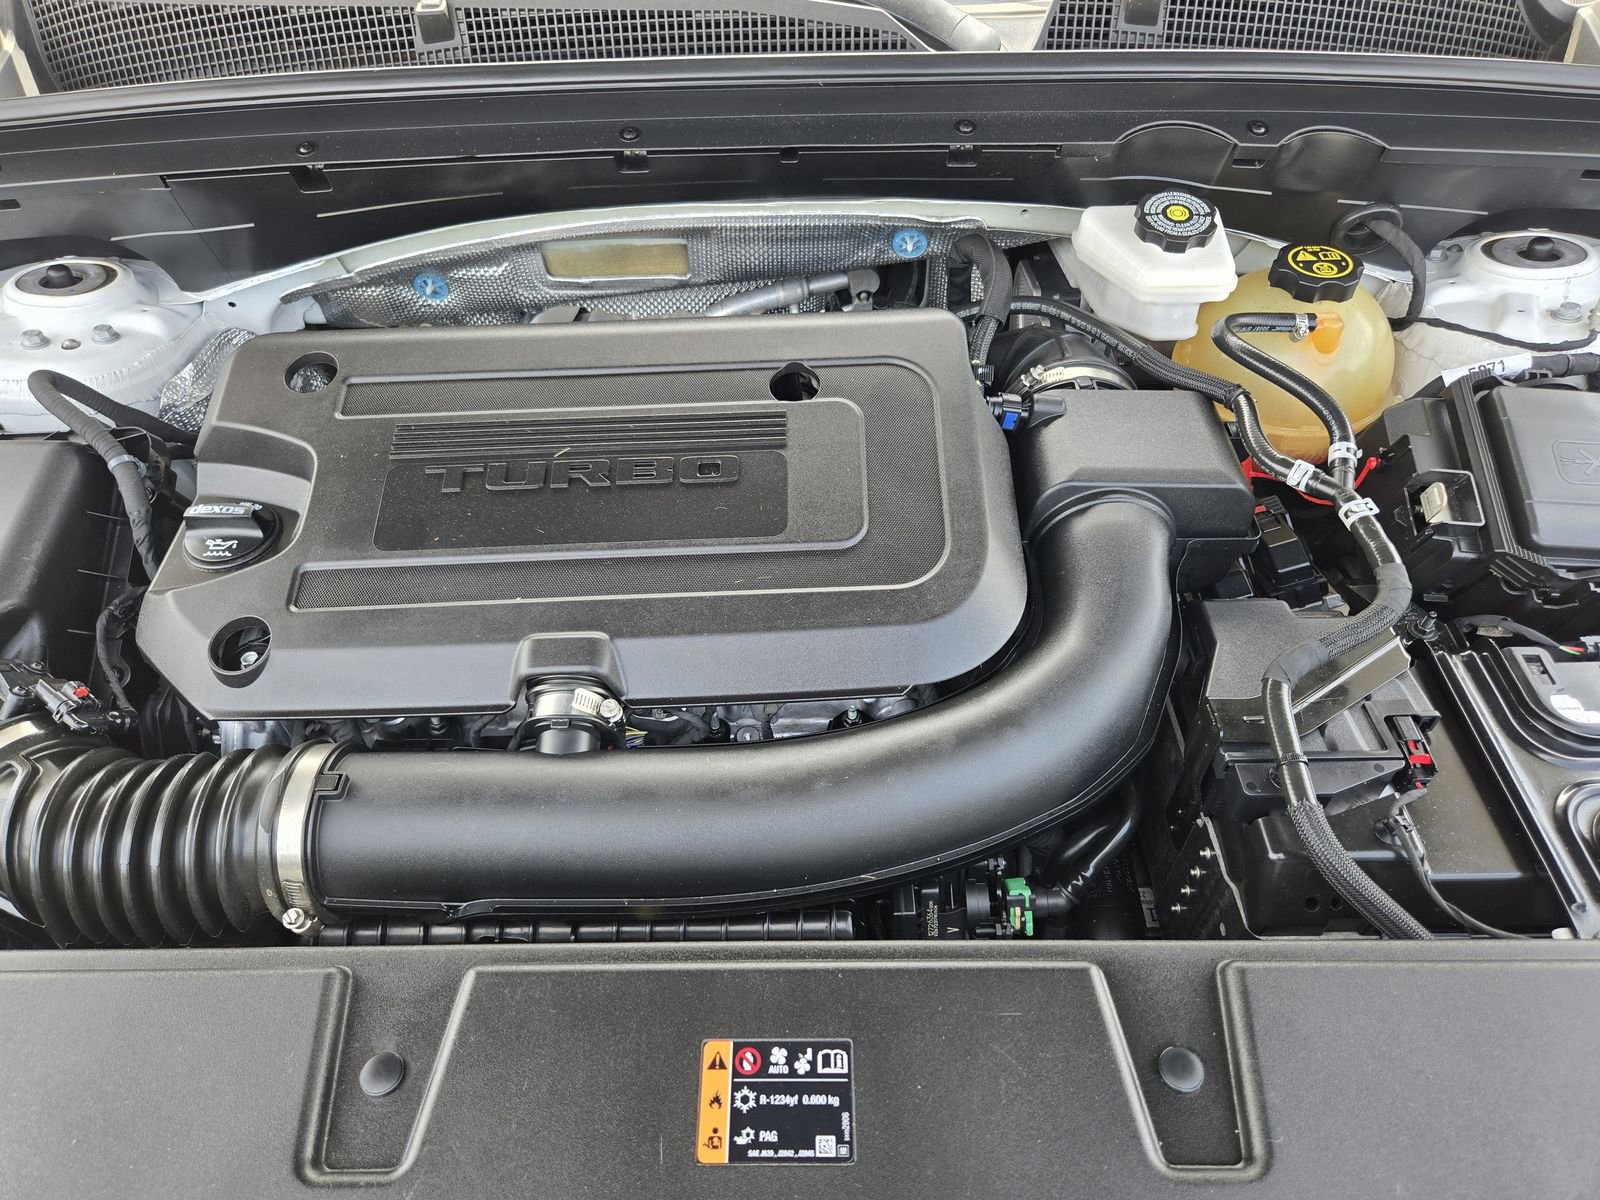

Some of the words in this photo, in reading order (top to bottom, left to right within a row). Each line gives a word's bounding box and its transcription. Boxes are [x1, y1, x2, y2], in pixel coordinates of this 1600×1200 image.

[425, 456, 740, 493] TURBO
[188, 504, 247, 515] dexos
[768, 1064, 789, 1074] AUTO
[759, 1094, 799, 1107] R-1234yf
[802, 1094, 828, 1105] 0.600
[828, 1094, 840, 1107] kg
[759, 1130, 778, 1142] PAG
